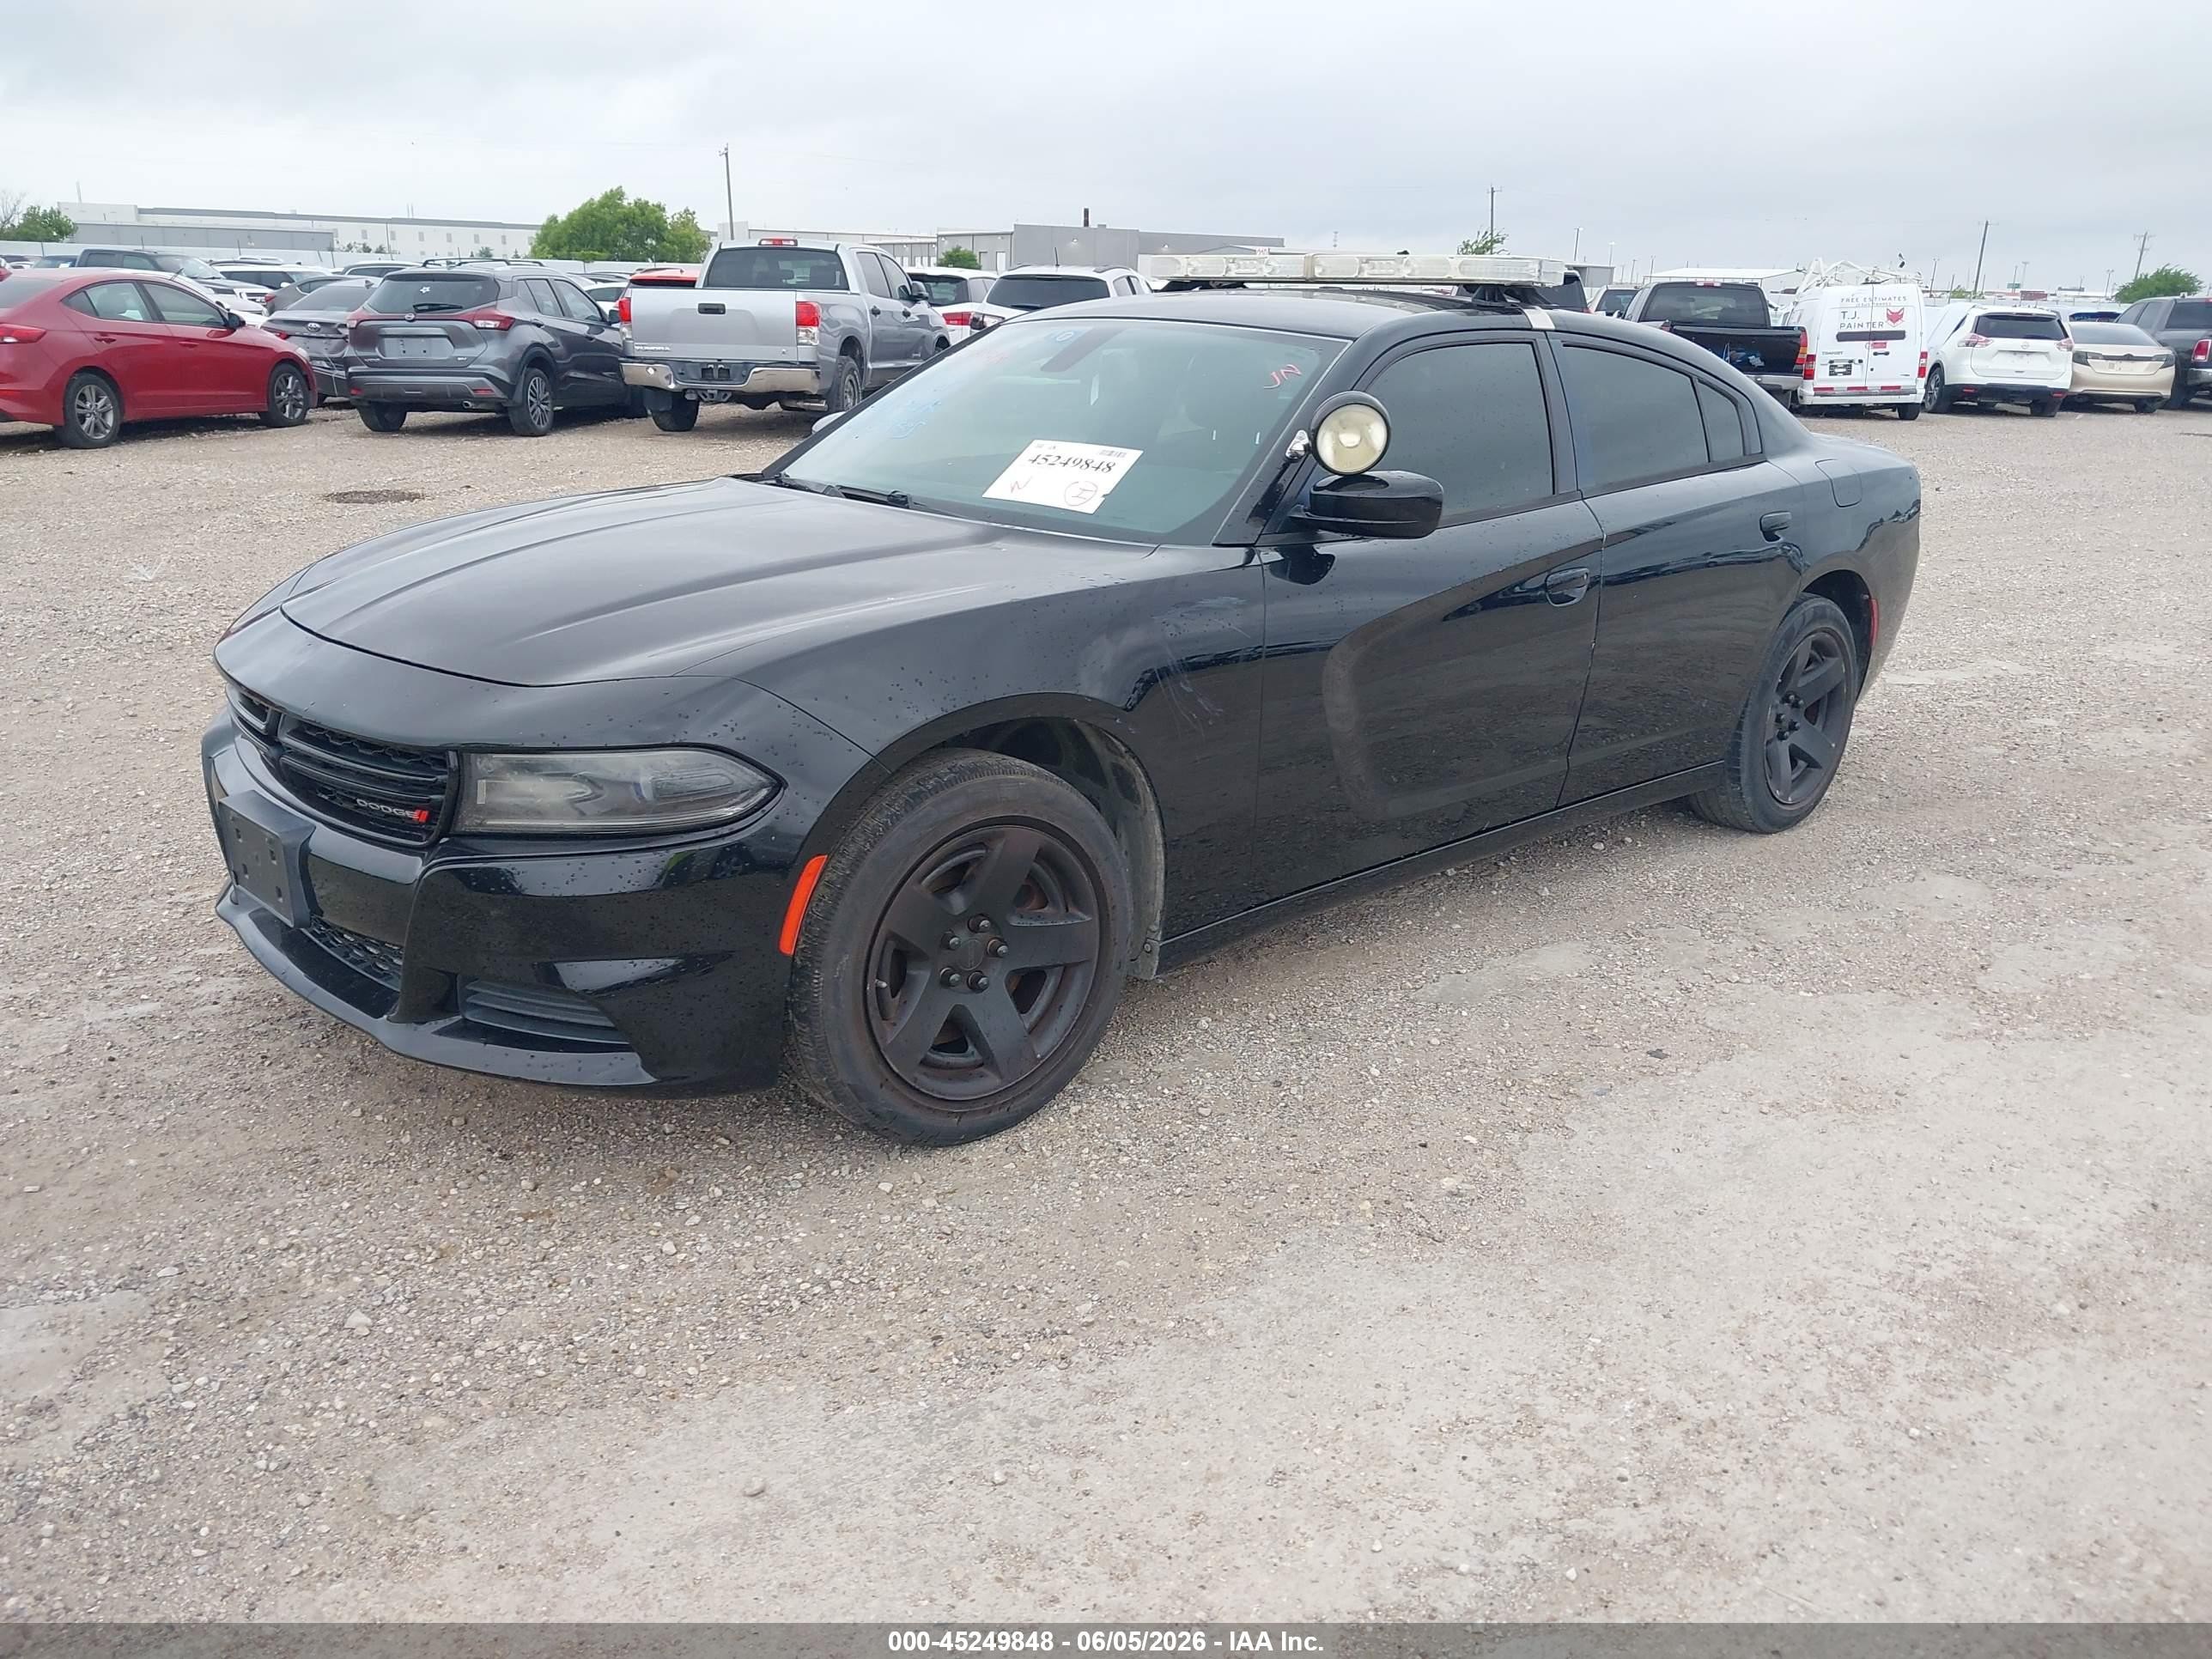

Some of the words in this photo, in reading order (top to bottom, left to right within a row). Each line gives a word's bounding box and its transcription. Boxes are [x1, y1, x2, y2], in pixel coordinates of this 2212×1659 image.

[1841, 310, 1860, 320] T.J.
[1839, 321, 1885, 330] PAINTER
[1028, 453, 1116, 473] 45249848
[356, 798, 420, 819] DODGE
